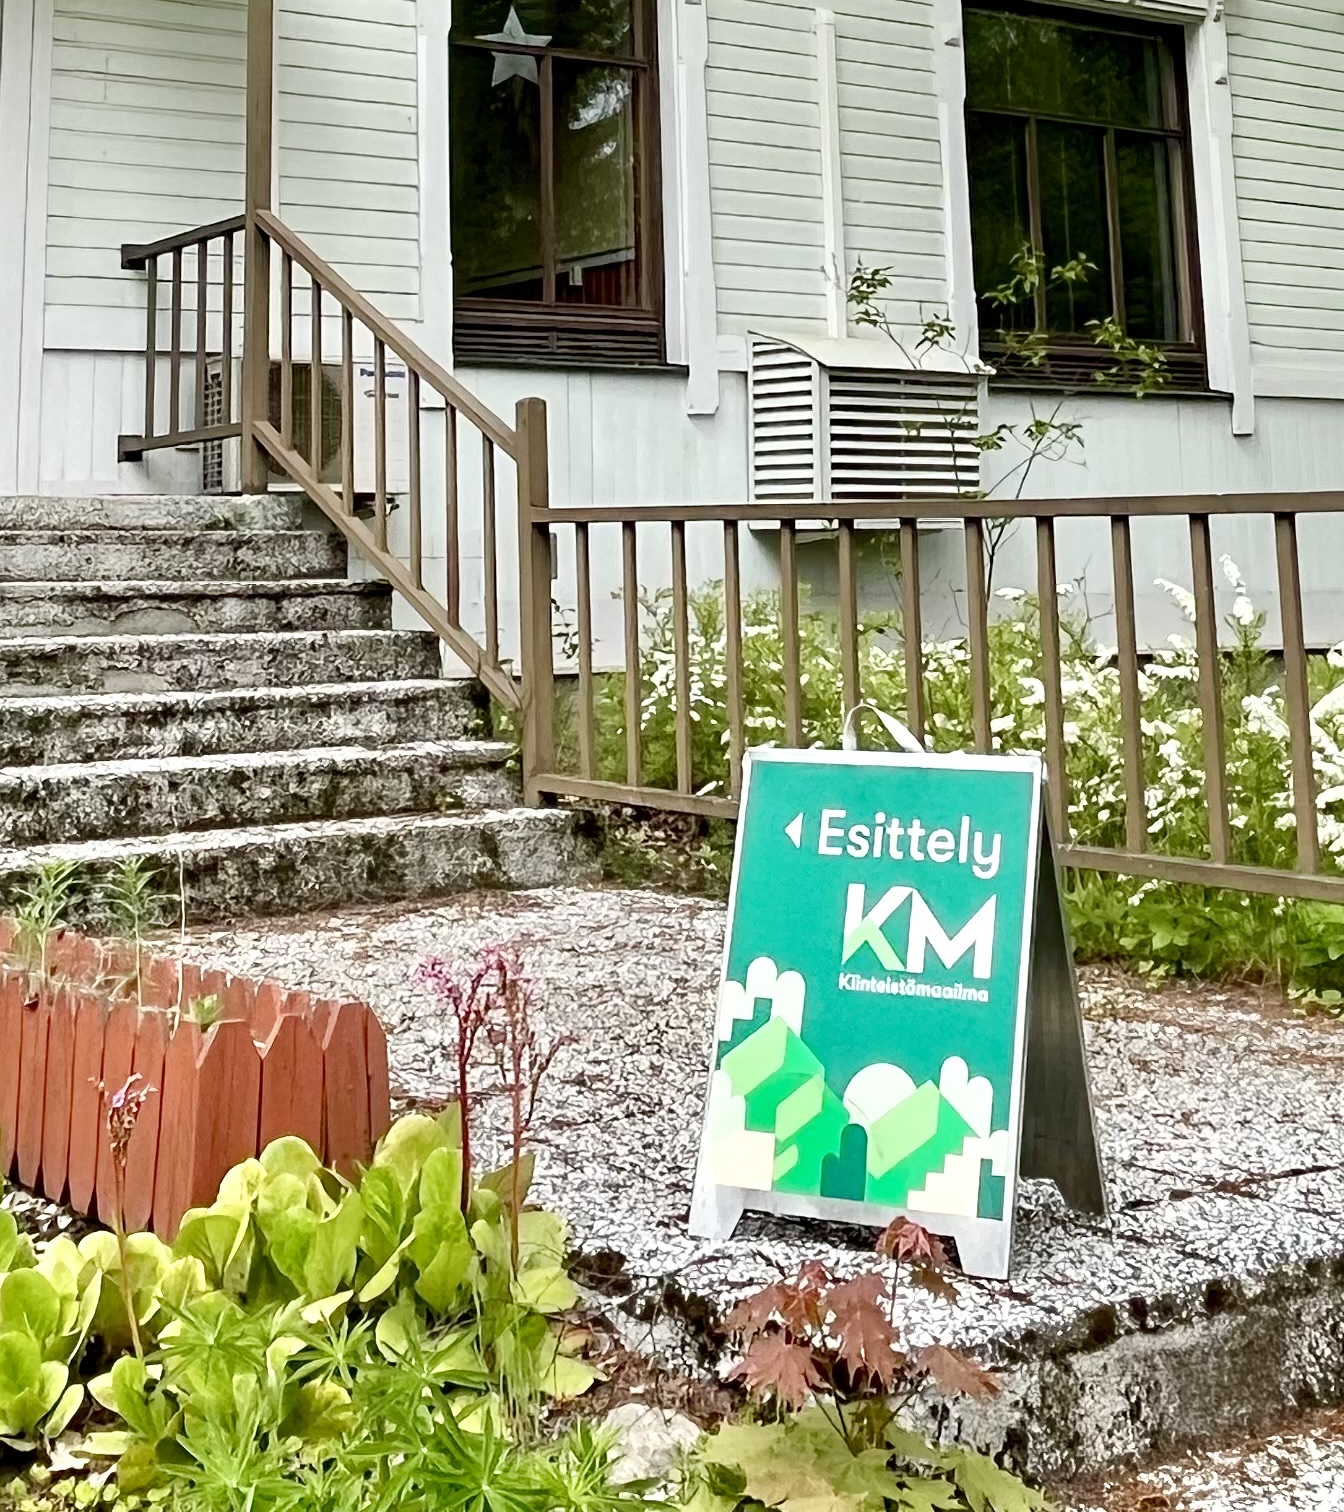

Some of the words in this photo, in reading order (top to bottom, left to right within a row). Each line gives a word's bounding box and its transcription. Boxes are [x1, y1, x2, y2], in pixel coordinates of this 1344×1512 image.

[817, 807, 1003, 881] Esittely
[840, 882, 997, 980] KM
[837, 972, 990, 1003] Kiinteistömaailma
